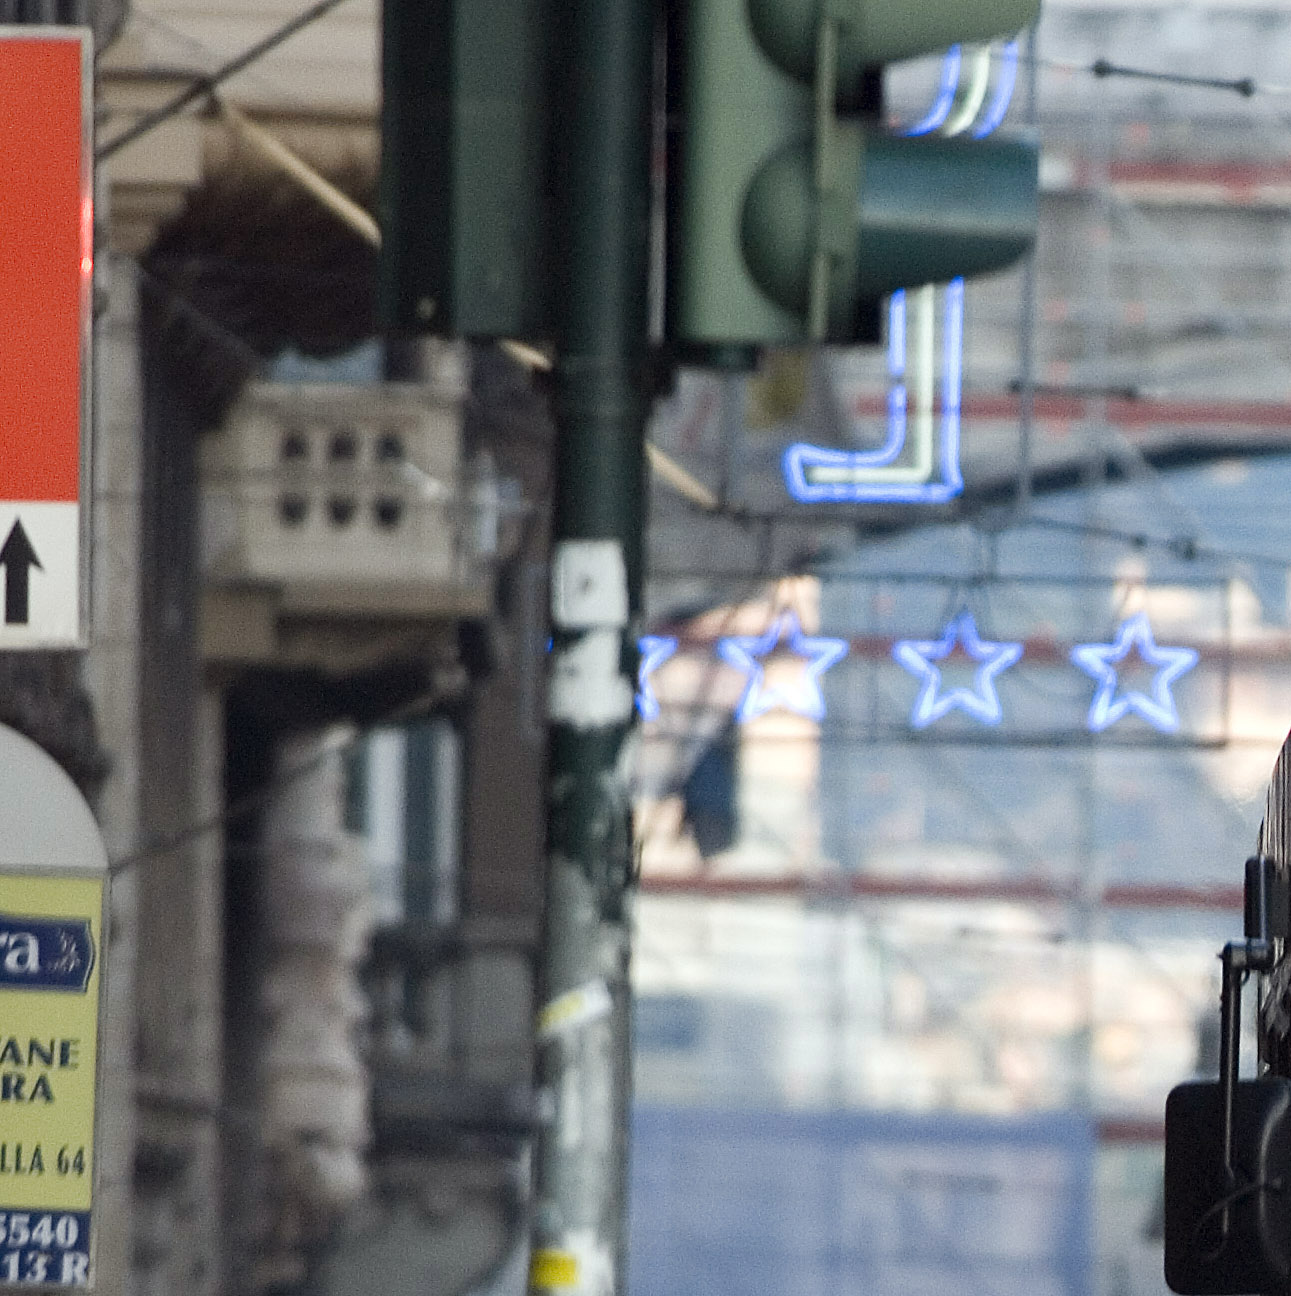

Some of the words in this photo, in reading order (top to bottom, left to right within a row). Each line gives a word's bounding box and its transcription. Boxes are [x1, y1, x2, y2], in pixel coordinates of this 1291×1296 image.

[0, 1035, 81, 1070] ANE
[57, 1143, 85, 1177] 64
[61, 1252, 90, 1286] R
